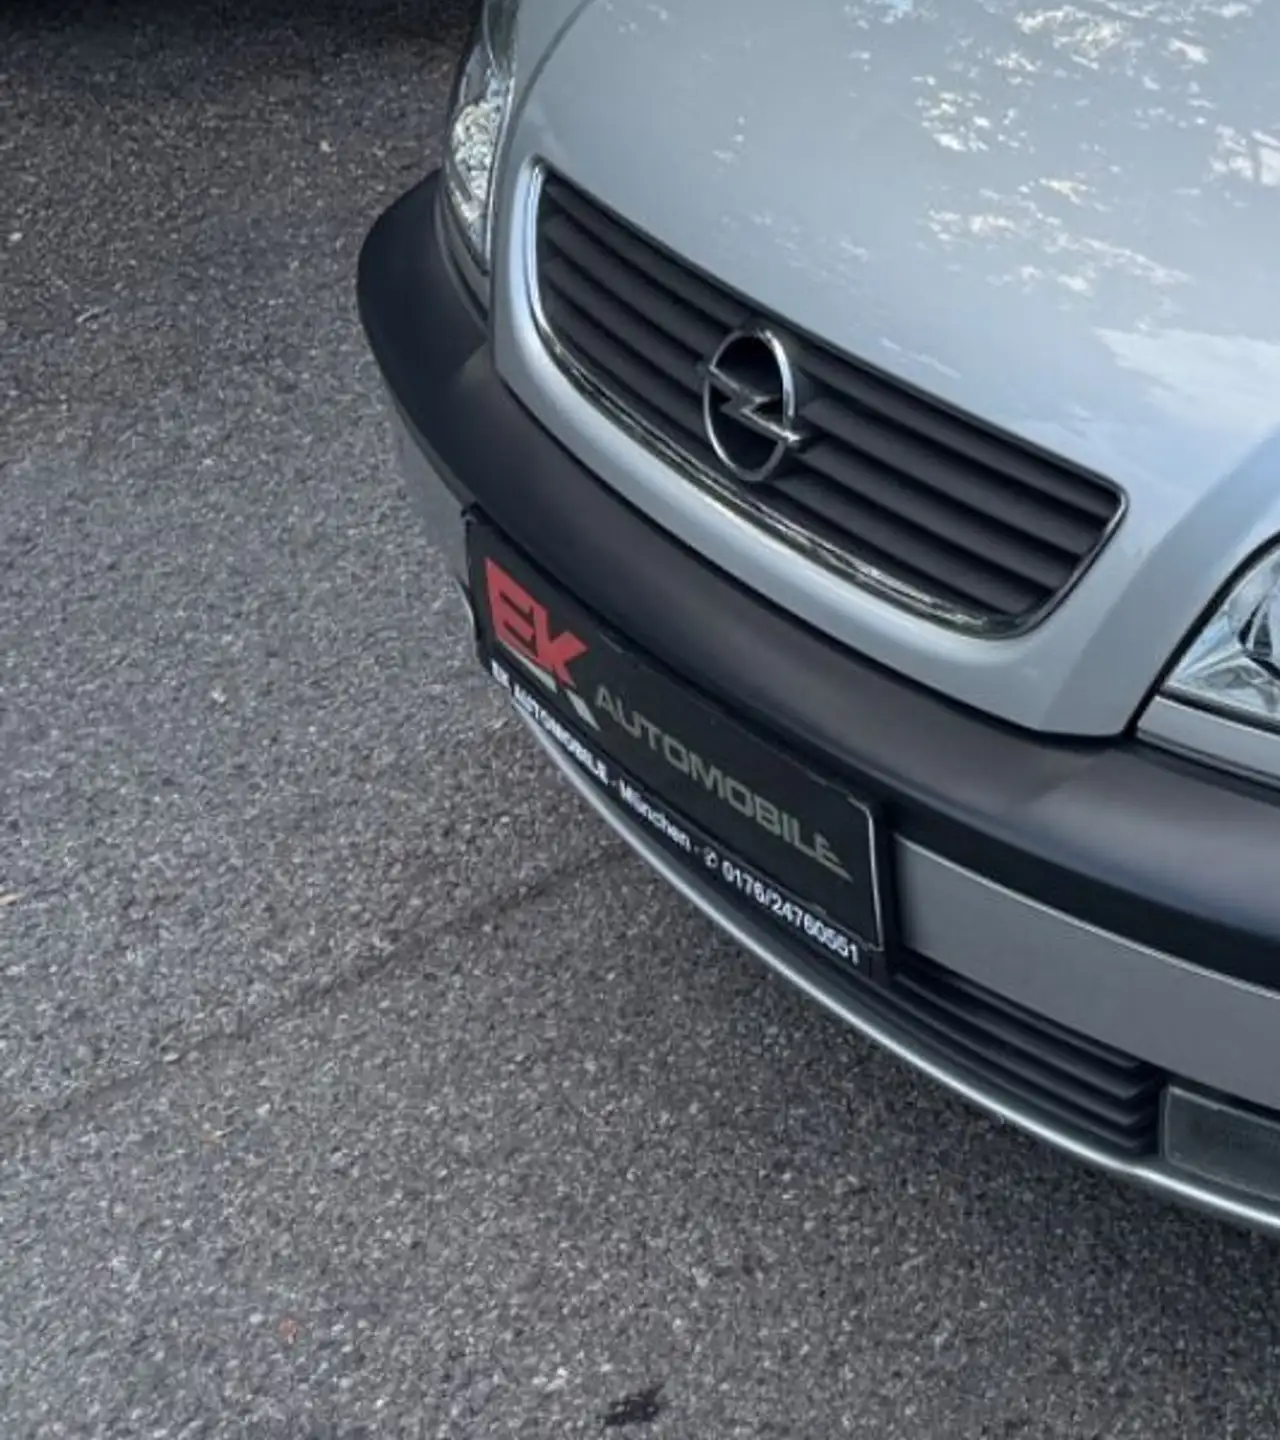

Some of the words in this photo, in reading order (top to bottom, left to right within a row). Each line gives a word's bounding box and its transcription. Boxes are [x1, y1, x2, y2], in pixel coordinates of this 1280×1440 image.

[484, 556, 594, 700] EK
[594, 683, 852, 883] AUTOMOBILE
[512, 684, 610, 786] AUTOMOBILE
[618, 778, 692, 851] München
